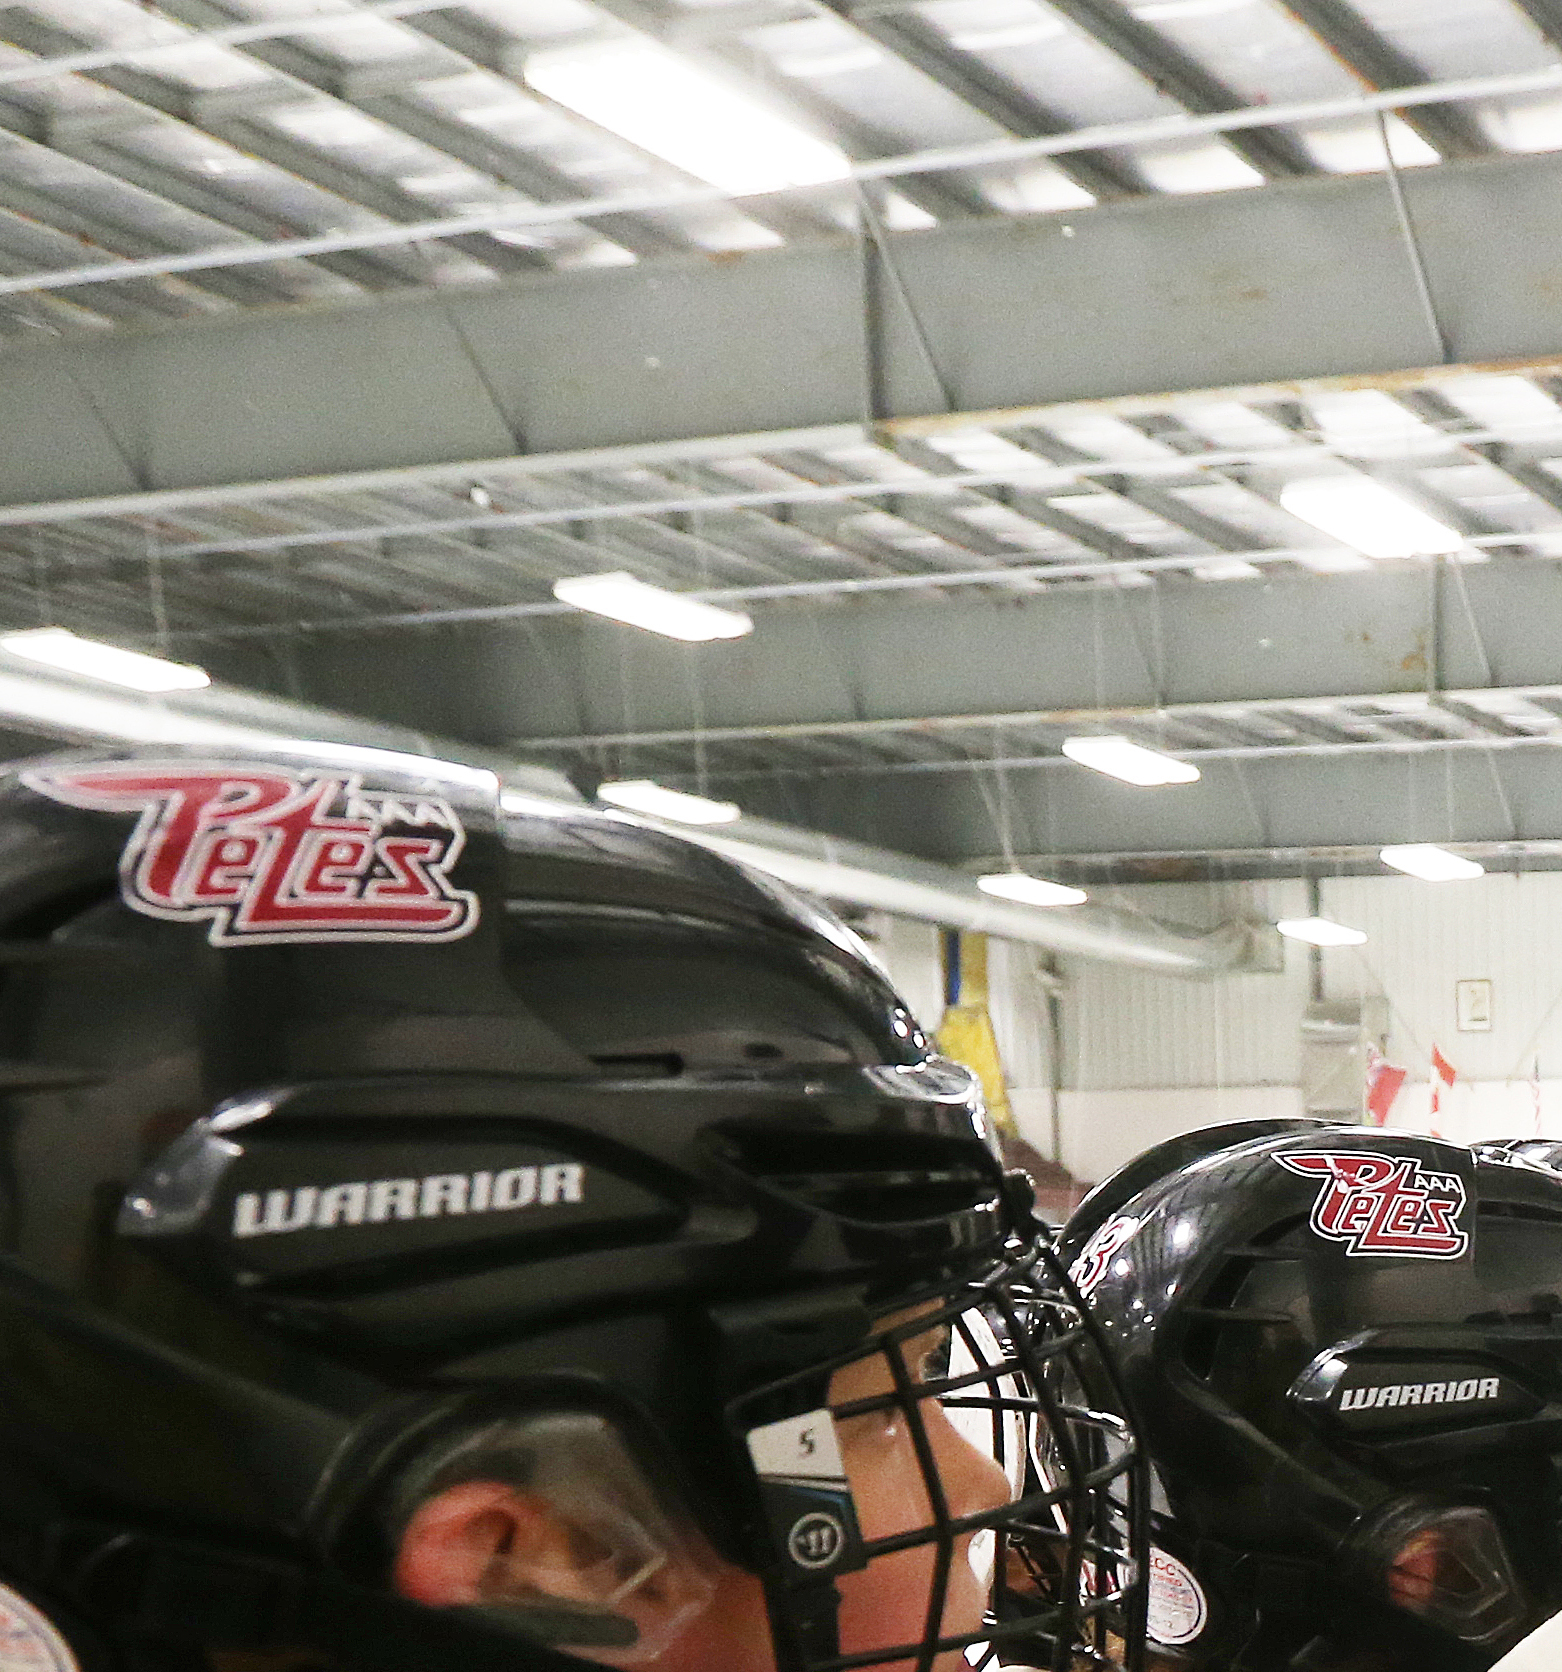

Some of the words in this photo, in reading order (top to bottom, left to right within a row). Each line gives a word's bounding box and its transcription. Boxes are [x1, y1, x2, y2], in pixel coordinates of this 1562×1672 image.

[233, 1161, 585, 1238] WARRIOR
[1413, 1173, 1461, 1194] AAA
[1339, 1376, 1500, 1412] WARRIOR
